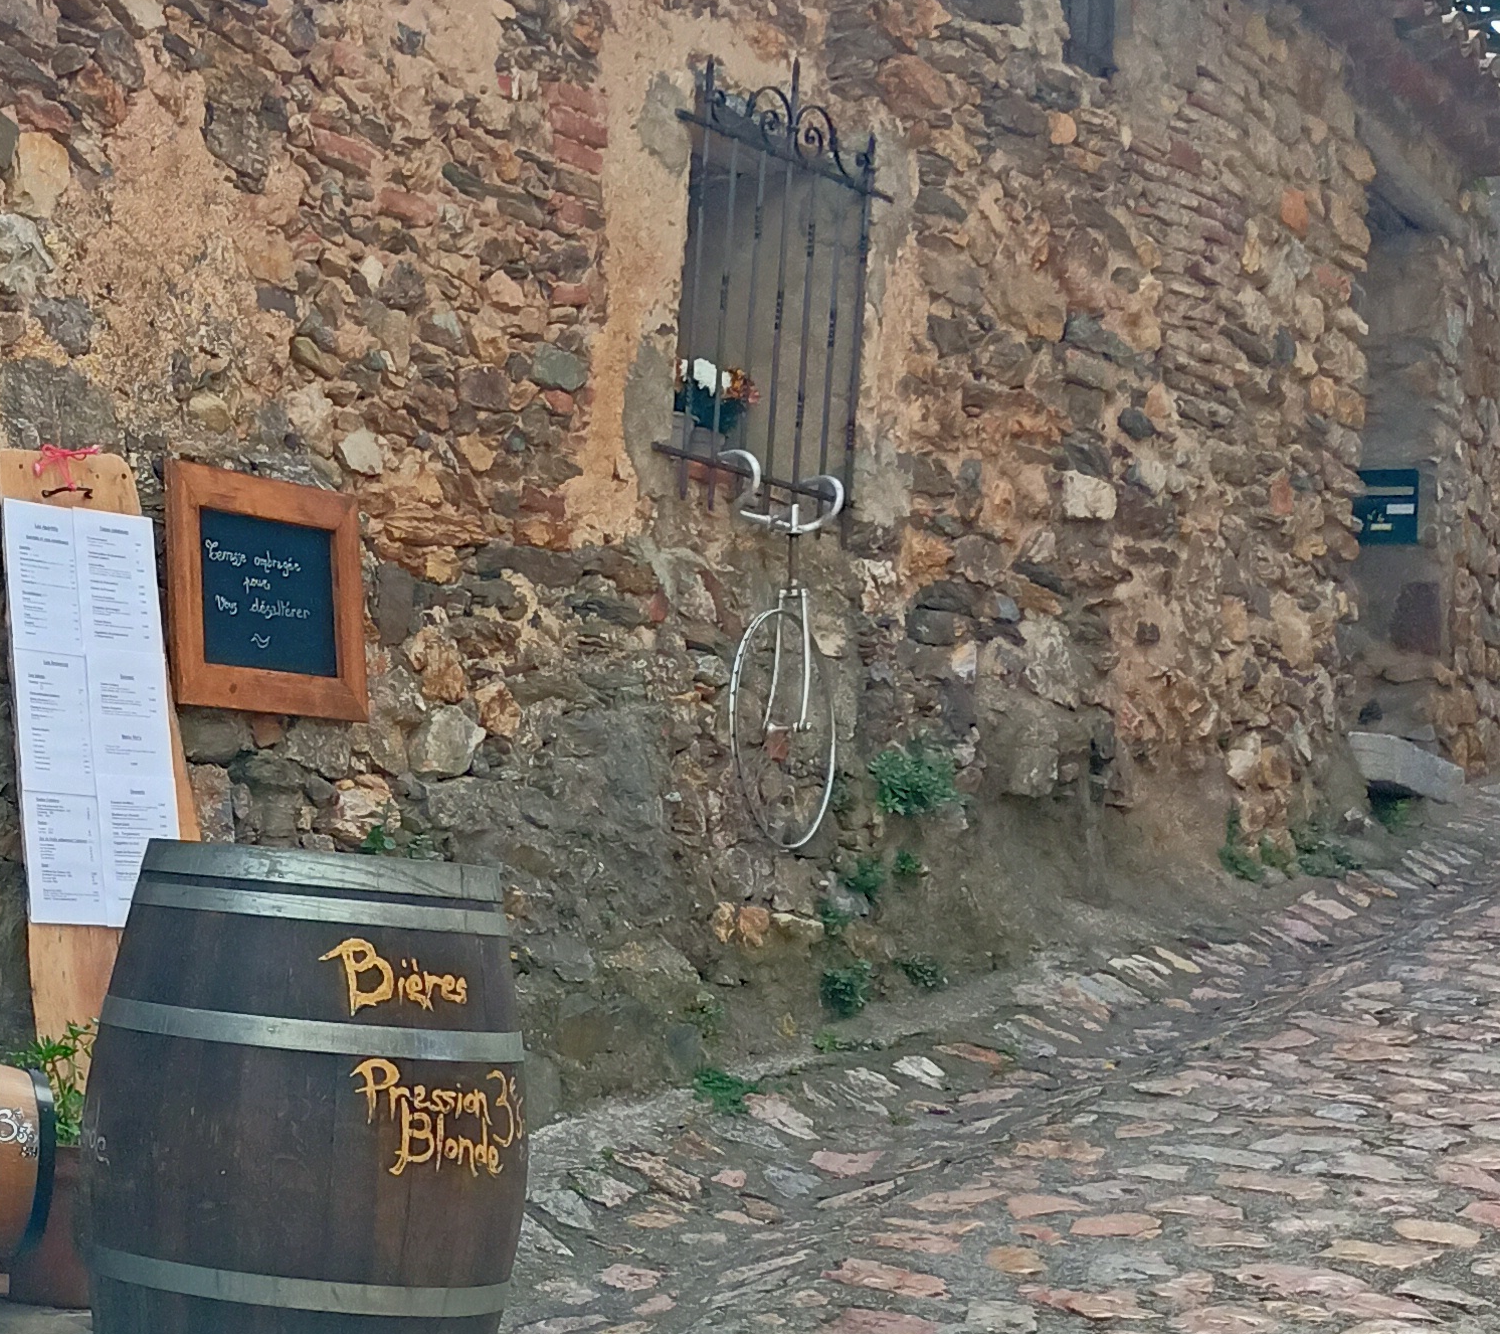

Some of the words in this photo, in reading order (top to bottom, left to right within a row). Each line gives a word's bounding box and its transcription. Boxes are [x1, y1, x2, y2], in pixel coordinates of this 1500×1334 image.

[243, 576, 271, 595] pour
[248, 597, 311, 619] désaltérer
[318, 937, 468, 1017] Bières
[349, 1057, 494, 1125] Pression
[389, 1096, 504, 1179] Blonde
